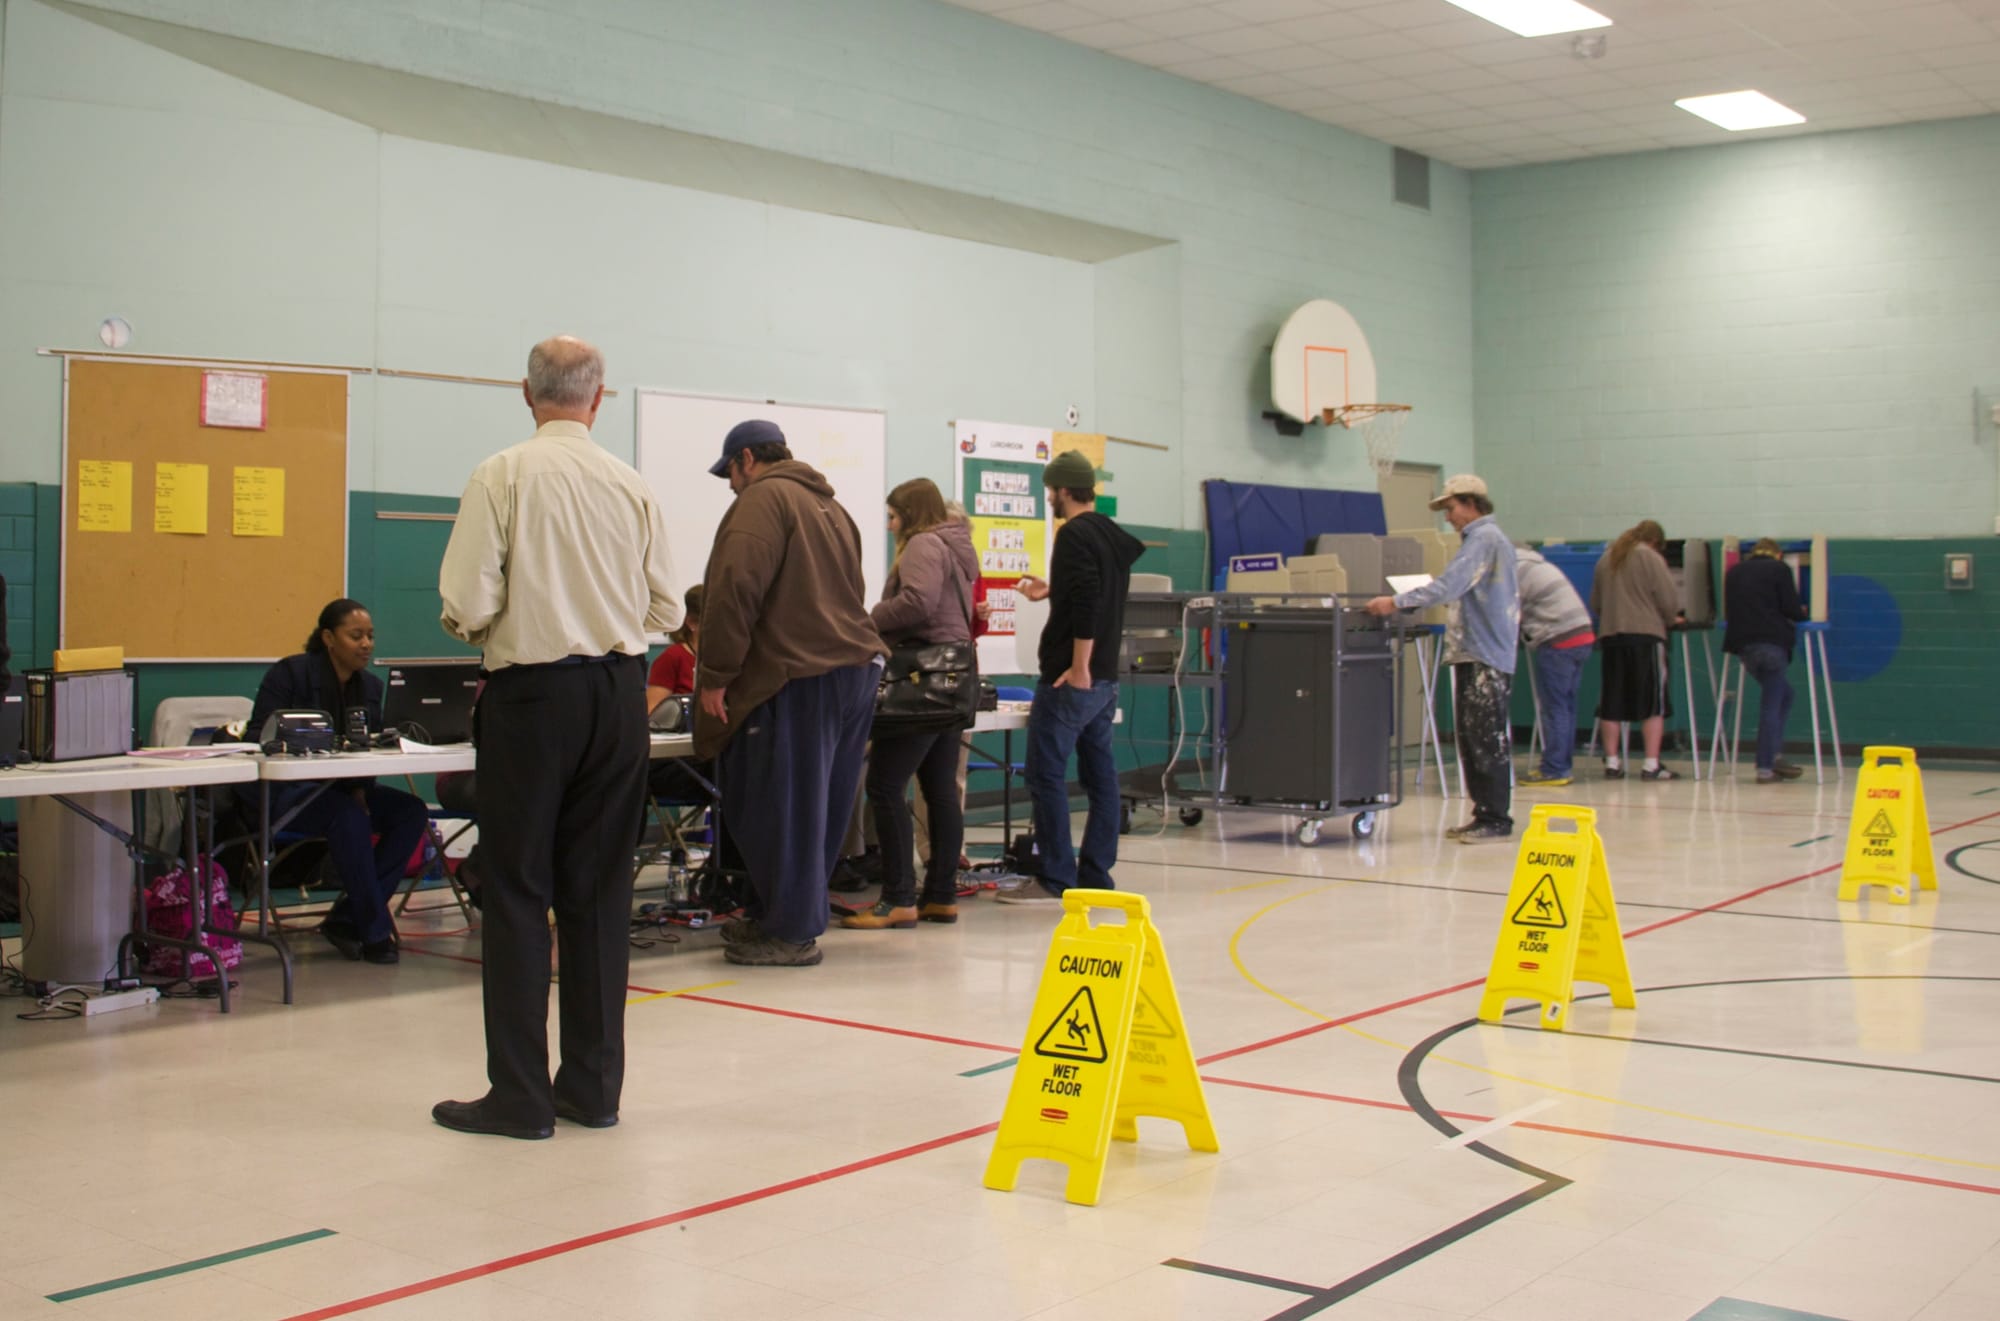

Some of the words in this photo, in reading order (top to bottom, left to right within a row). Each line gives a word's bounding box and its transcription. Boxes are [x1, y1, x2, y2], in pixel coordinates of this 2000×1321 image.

[1867, 788, 1901, 800] CAUTION
[1870, 838, 1889, 847] WET
[1862, 848, 1894, 857] FLOOR
[1527, 851, 1575, 868] CAUTION
[1526, 930, 1546, 941] WET
[1518, 941, 1549, 954] FLOOR
[1059, 954, 1123, 979] CAUTION
[1052, 1063, 1079, 1080] WET
[1041, 1078, 1082, 1097] FLOOR
